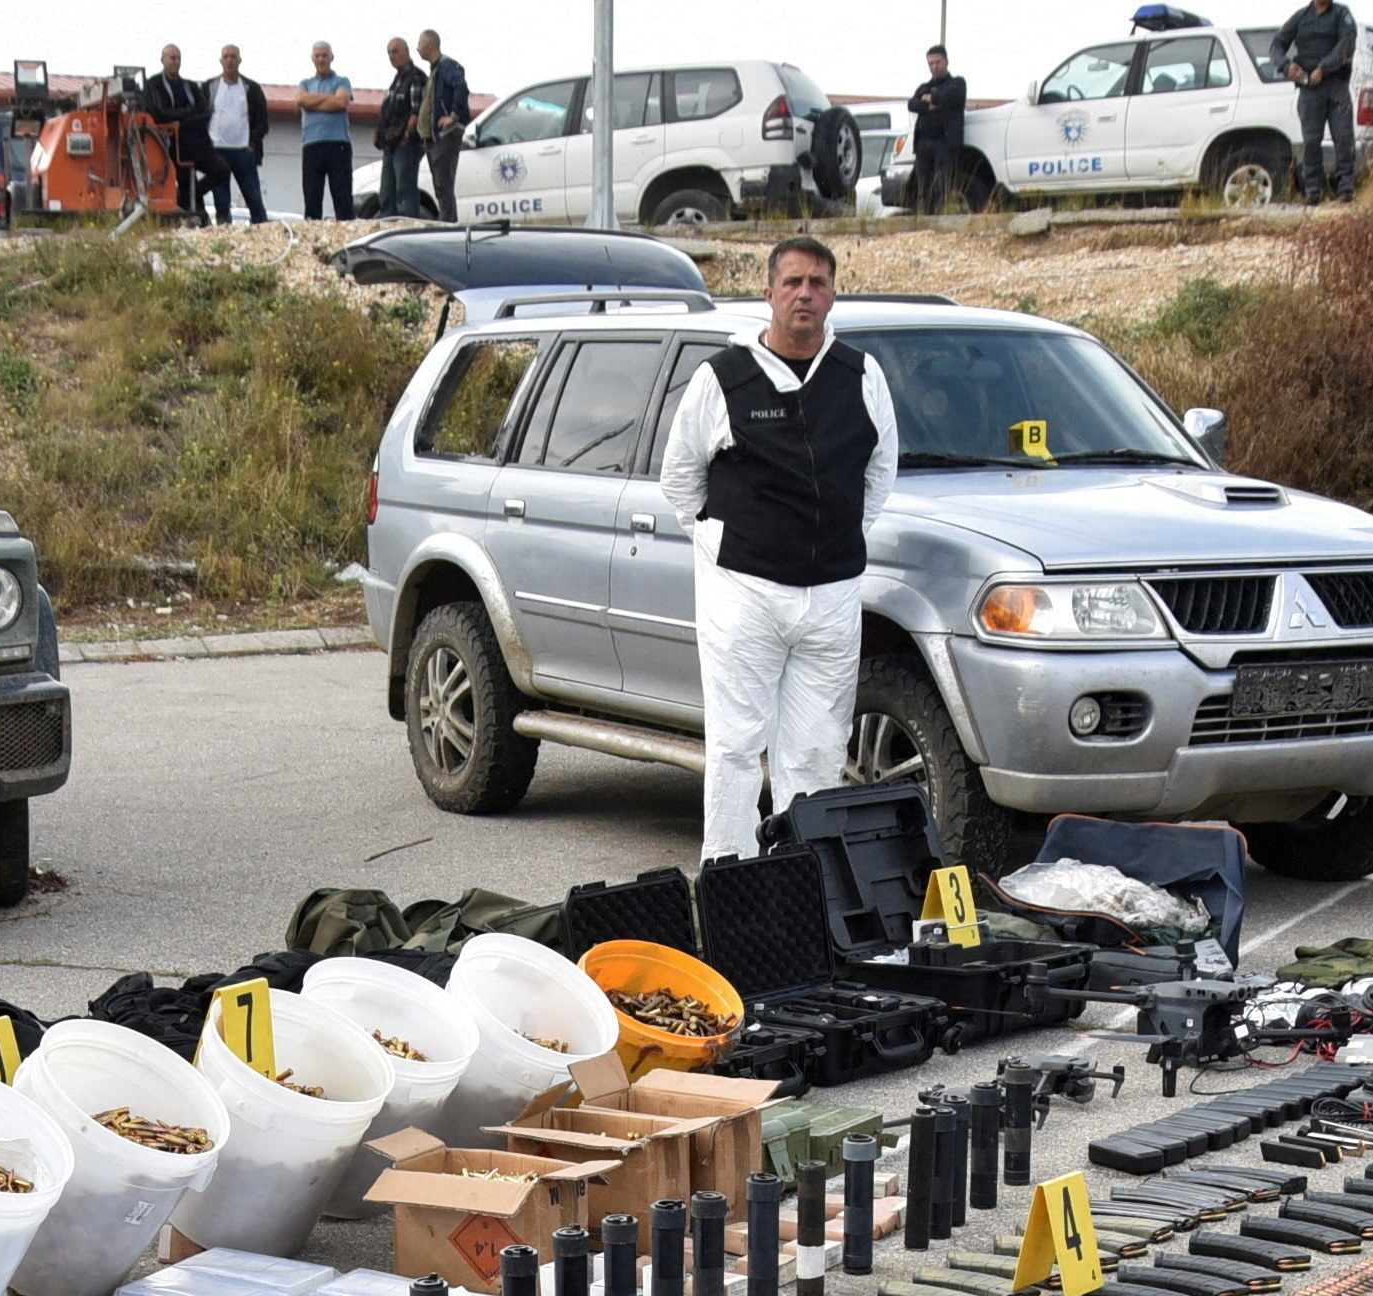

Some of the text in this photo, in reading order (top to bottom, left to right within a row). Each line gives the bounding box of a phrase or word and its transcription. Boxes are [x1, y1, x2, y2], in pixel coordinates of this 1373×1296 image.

[1028, 157, 1103, 175] POLICE
[475, 198, 543, 216] POLICE
[750, 408, 787, 419] POLICE
[1029, 425, 1041, 444] B
[948, 872, 966, 924] 3
[236, 991, 254, 1063] 7
[1062, 1186, 1082, 1261] 4
